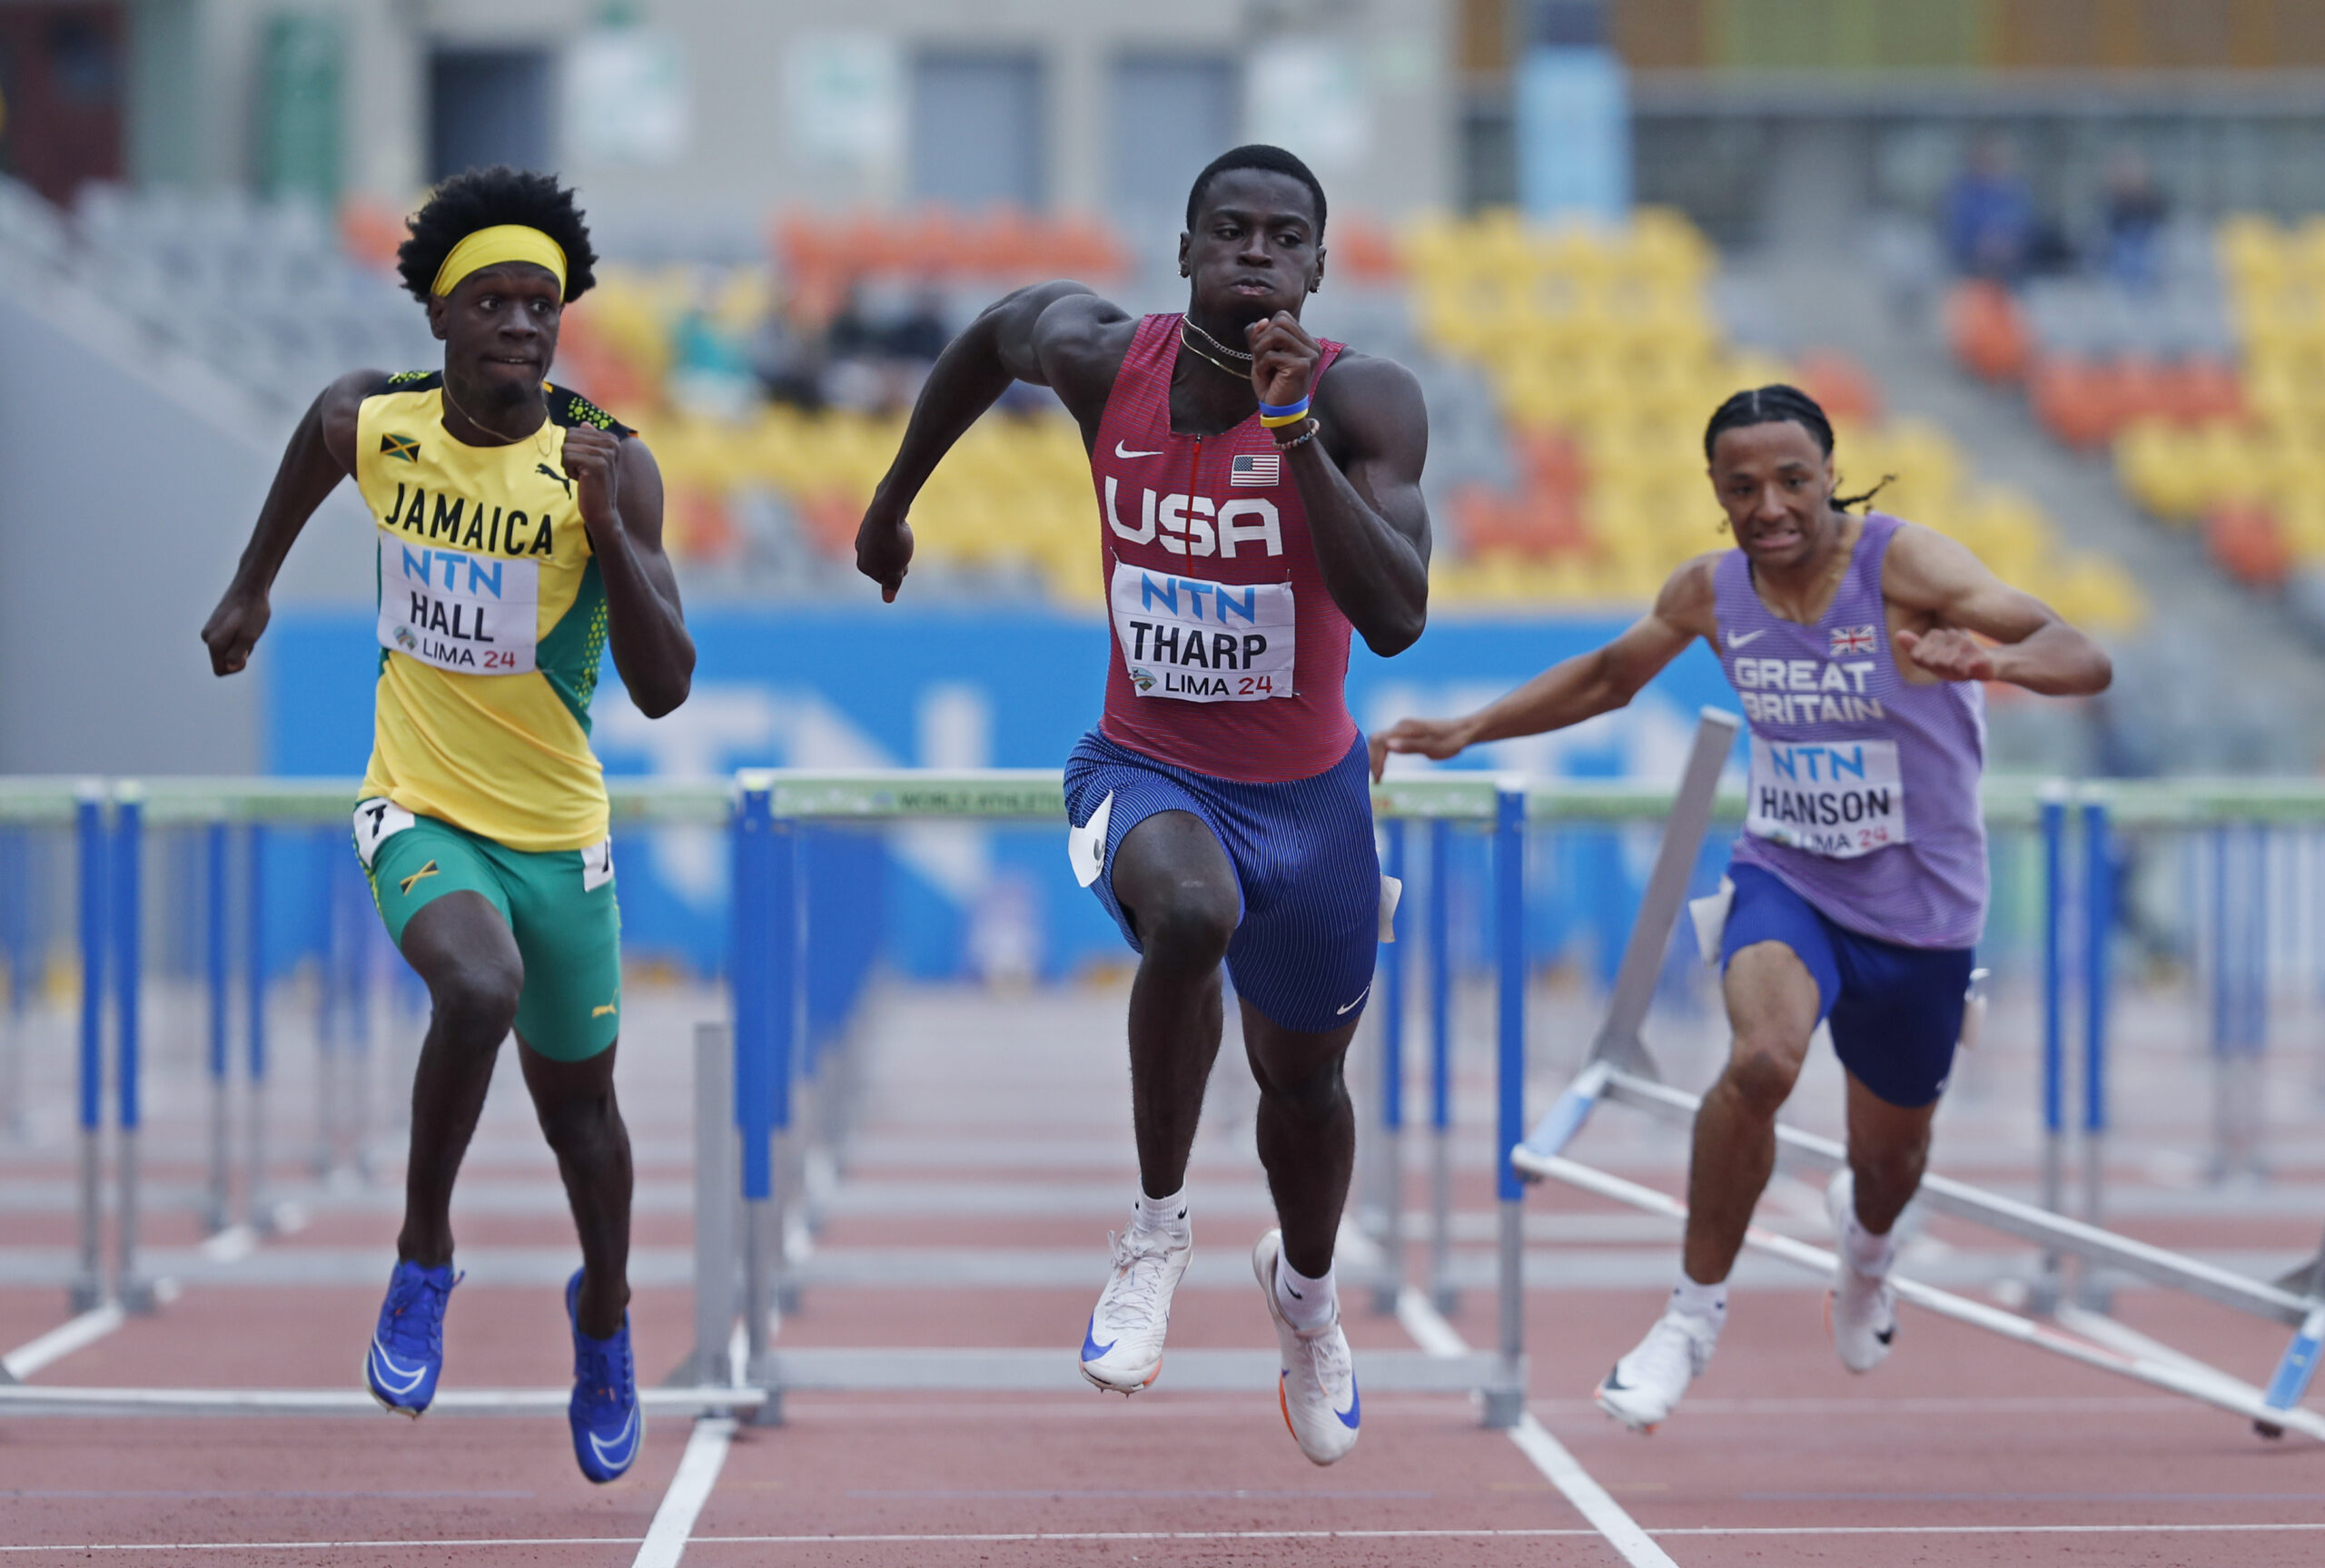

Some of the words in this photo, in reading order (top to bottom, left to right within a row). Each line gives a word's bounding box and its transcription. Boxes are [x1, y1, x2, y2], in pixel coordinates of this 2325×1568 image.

[384, 482, 553, 556] JAMAICA
[1105, 475, 1283, 558] USA
[401, 544, 502, 600] NTN
[411, 591, 494, 642] HALL
[1141, 571, 1255, 625] NTN
[423, 637, 476, 666] LIMA
[483, 650, 515, 668] 24
[1129, 621, 1267, 670] THARP
[1165, 672, 1230, 695] LIMA
[1238, 676, 1272, 695] 24
[1734, 657, 1875, 693] GREAT
[1739, 691, 1885, 724] BRITAIN
[1769, 745, 1865, 783] NTN
[365, 804, 388, 839] 7
[1760, 786, 1890, 826] HANSON
[1858, 823, 1888, 849] 24
